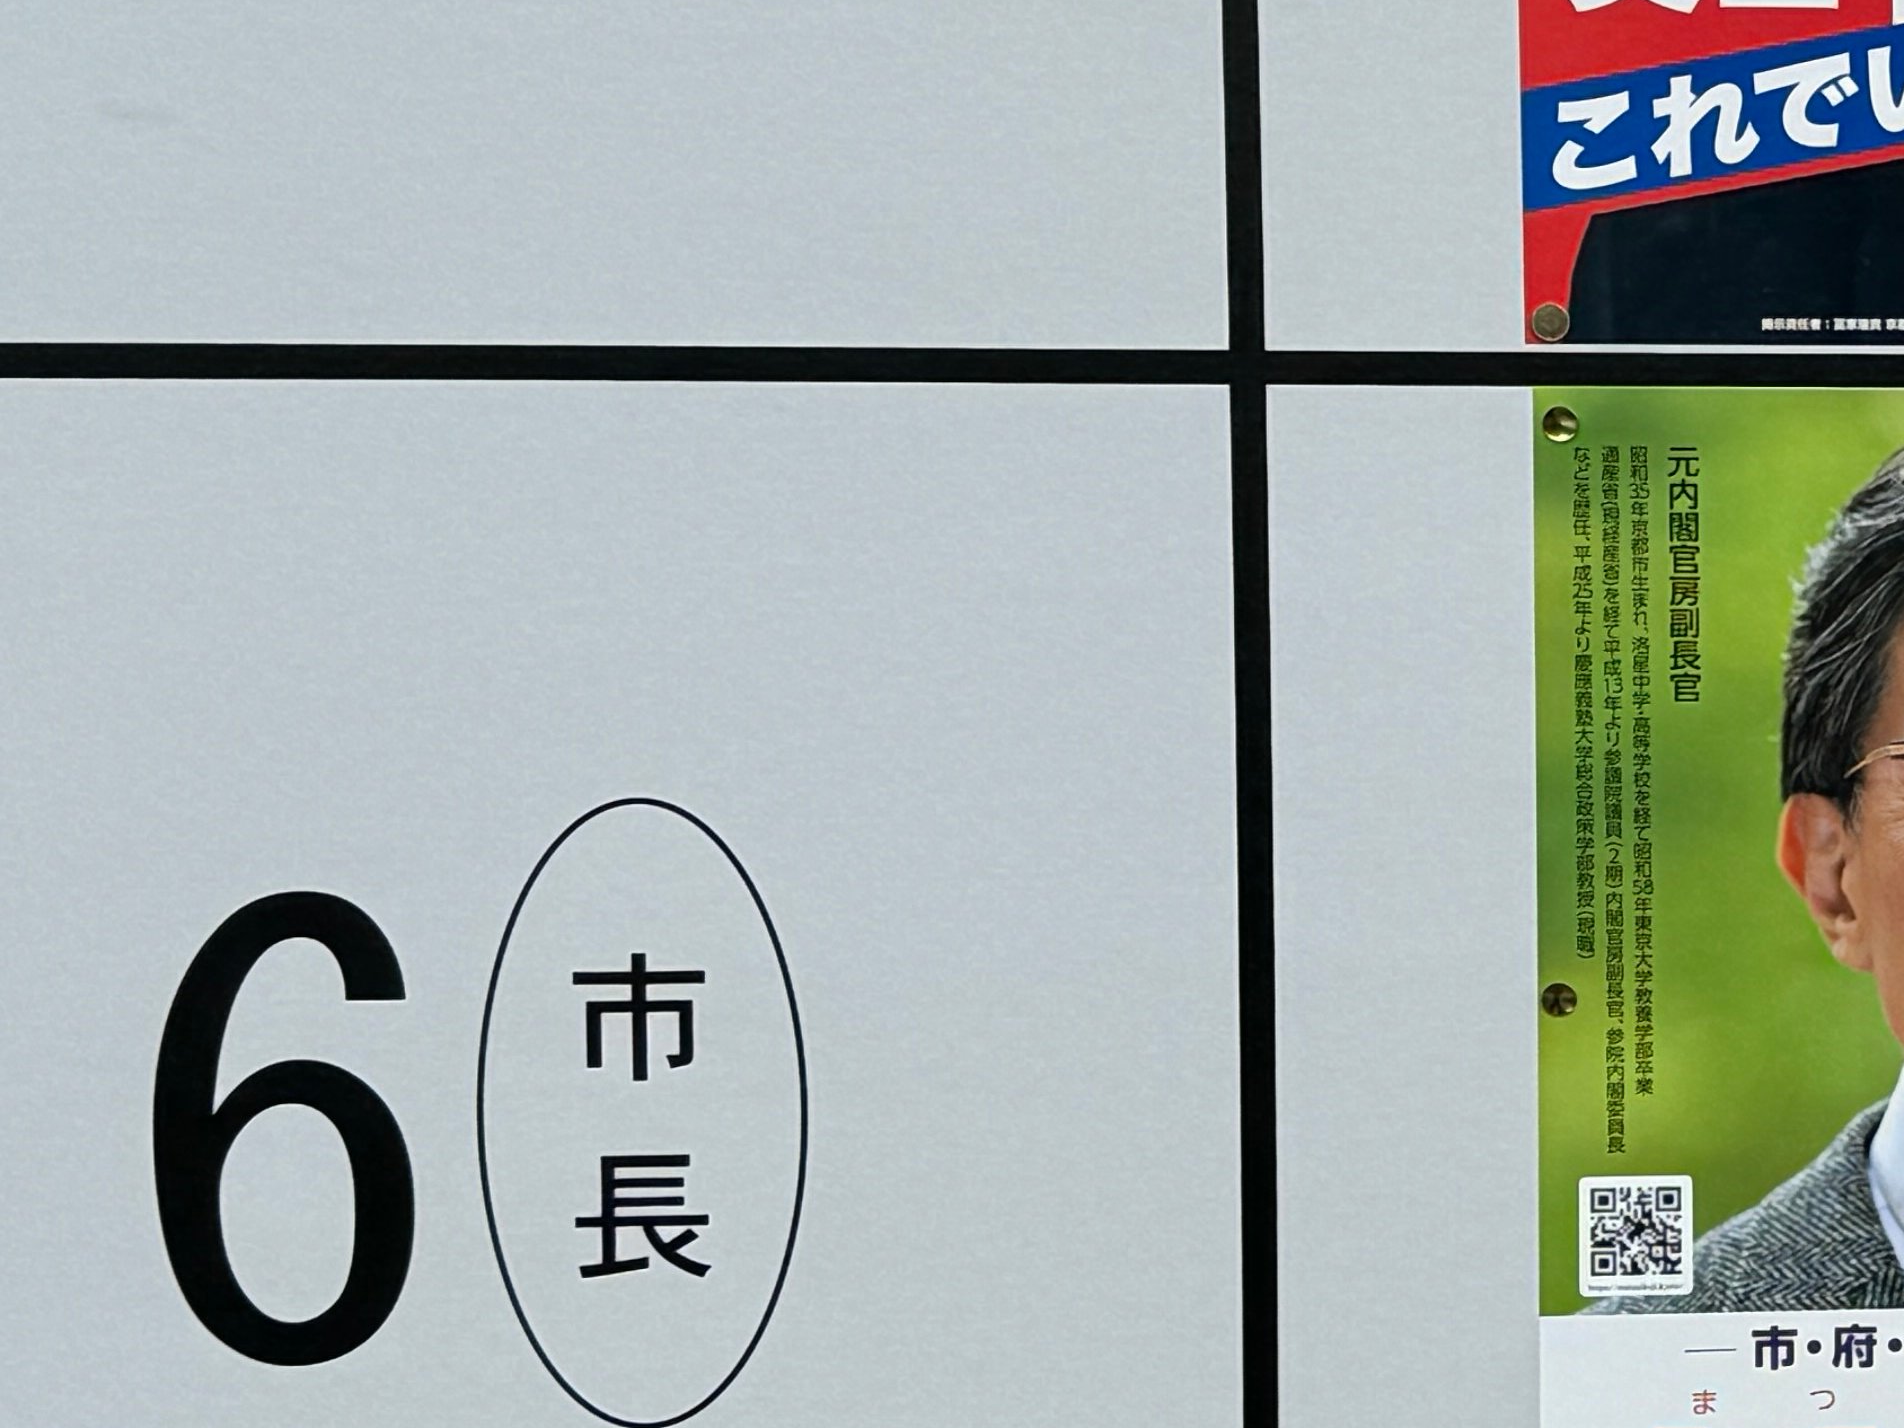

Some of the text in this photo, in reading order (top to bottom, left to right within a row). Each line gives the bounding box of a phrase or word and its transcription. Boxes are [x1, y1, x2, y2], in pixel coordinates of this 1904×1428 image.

[1666, 445, 1702, 703] 元内閣官房副長官
[149, 890, 417, 1368] 6
[570, 952, 714, 1281] 市長
